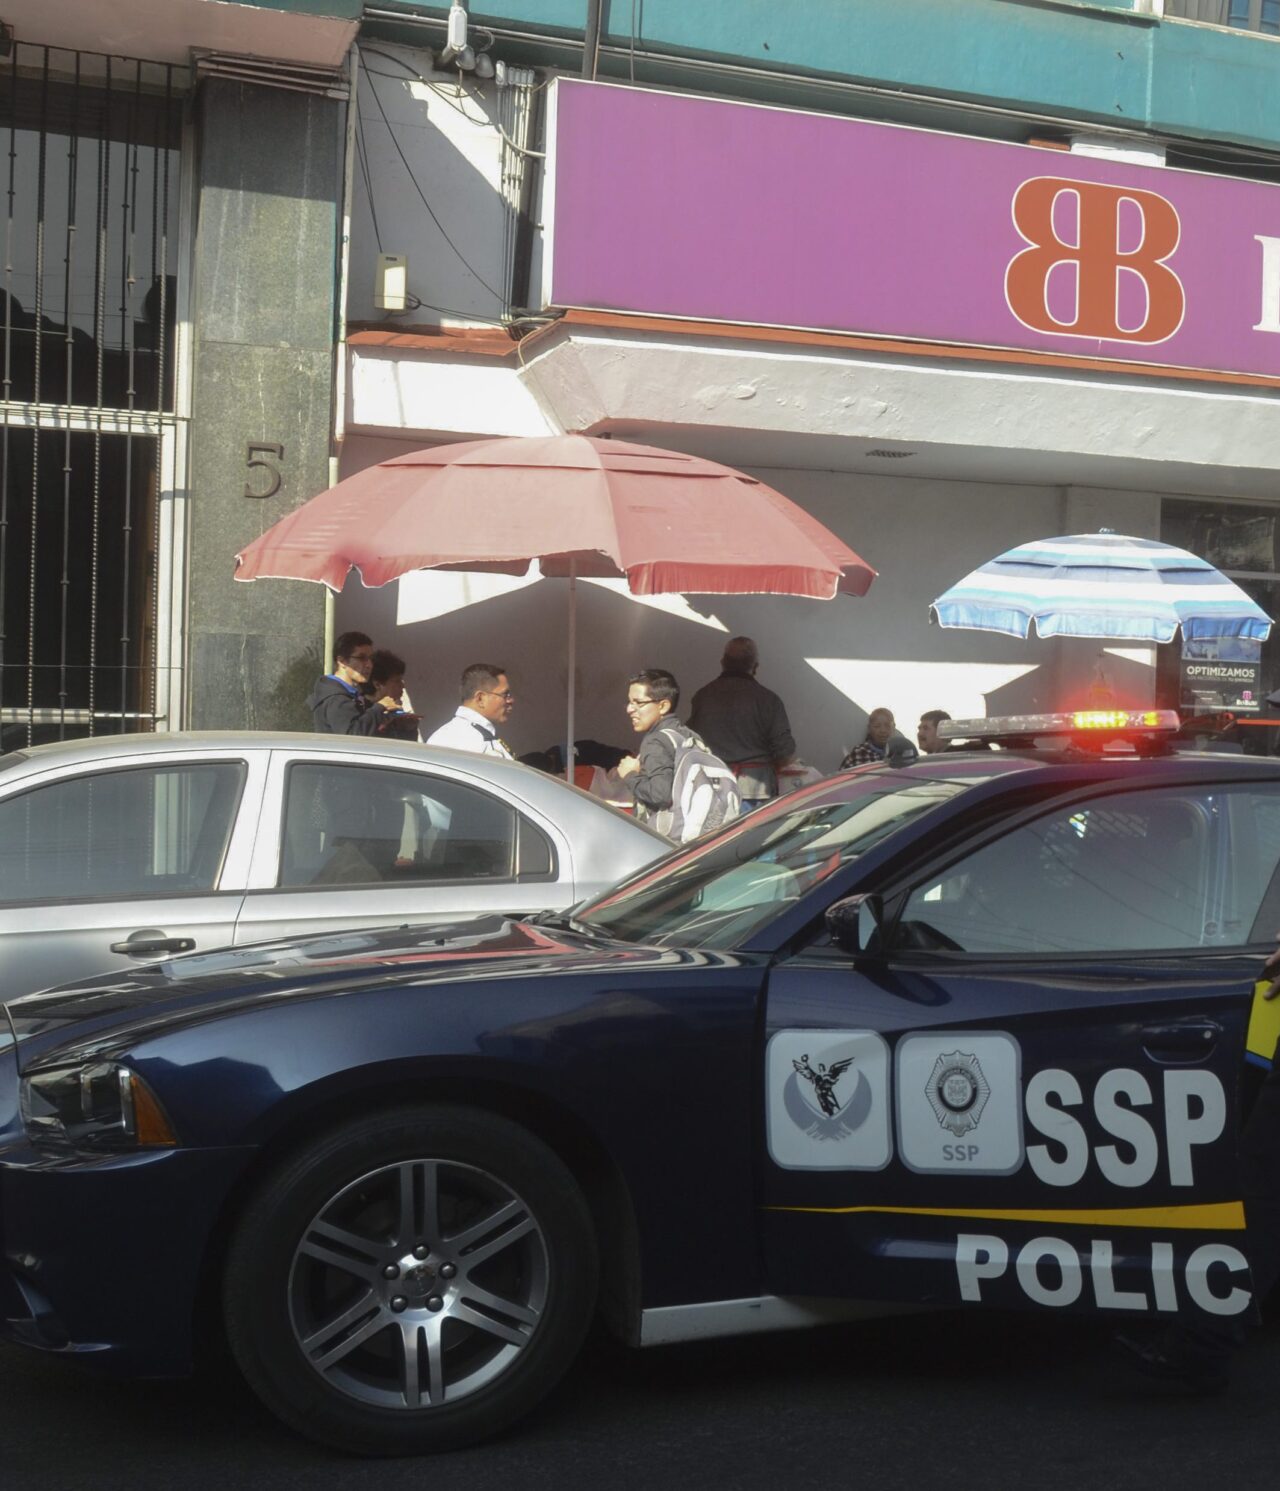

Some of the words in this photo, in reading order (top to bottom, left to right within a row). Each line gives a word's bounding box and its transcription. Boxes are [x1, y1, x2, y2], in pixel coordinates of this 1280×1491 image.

[244, 441, 285, 499] 5
[1186, 665, 1255, 678] OPTIMIZAMOS
[942, 1144, 980, 1161] SSP
[1025, 1068, 1227, 1188] SSP
[955, 1233, 1252, 1316] POLIC
